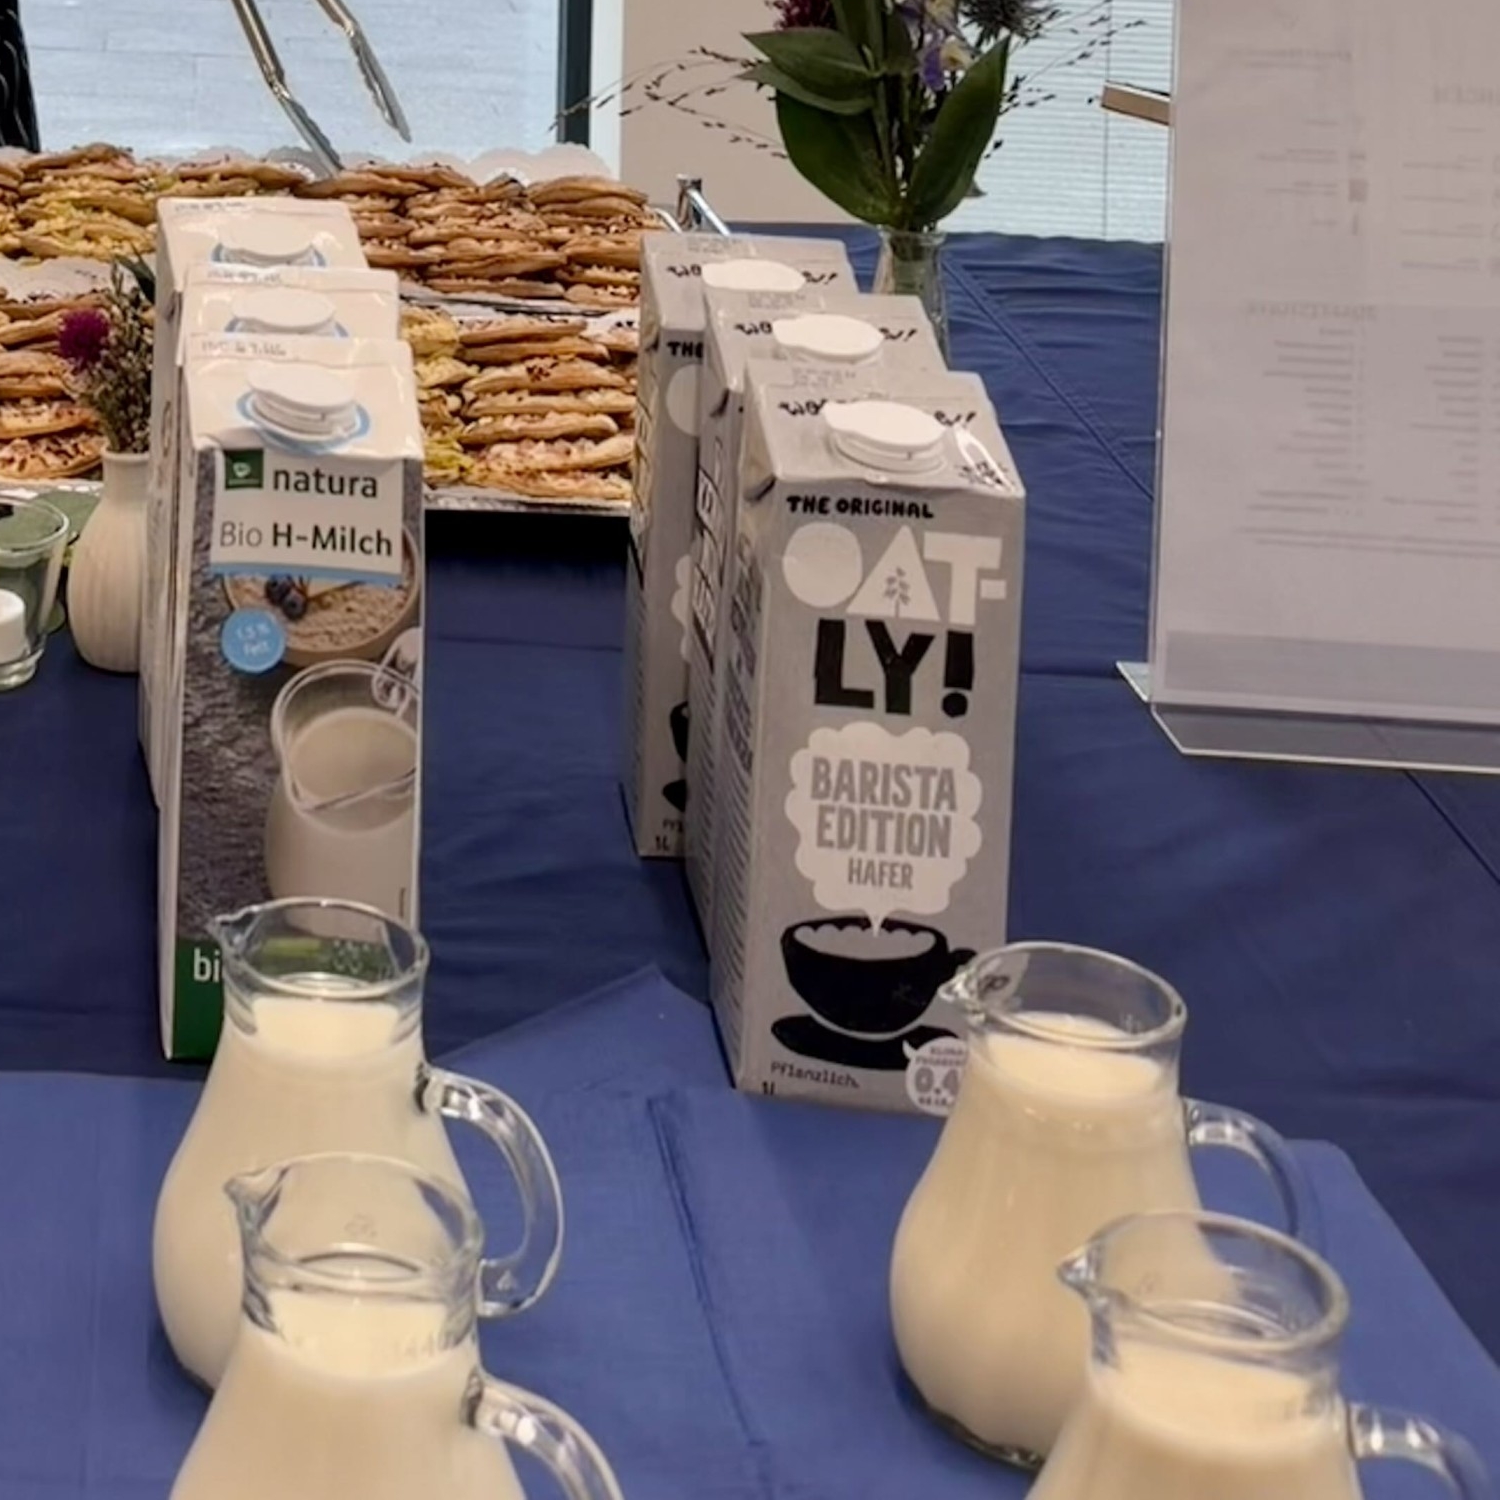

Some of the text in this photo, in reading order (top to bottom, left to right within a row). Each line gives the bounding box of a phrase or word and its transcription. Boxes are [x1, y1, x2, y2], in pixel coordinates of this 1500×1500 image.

[272, 467, 378, 498] natura
[786, 496, 934, 519] THE ORIGINAL
[219, 521, 393, 557] Bio H-Milch
[813, 618, 975, 718] LY!
[810, 756, 958, 812] BARISTA
[815, 805, 953, 859] EDITION
[847, 857, 914, 891] HAFER
[192, 949, 222, 983] bi
